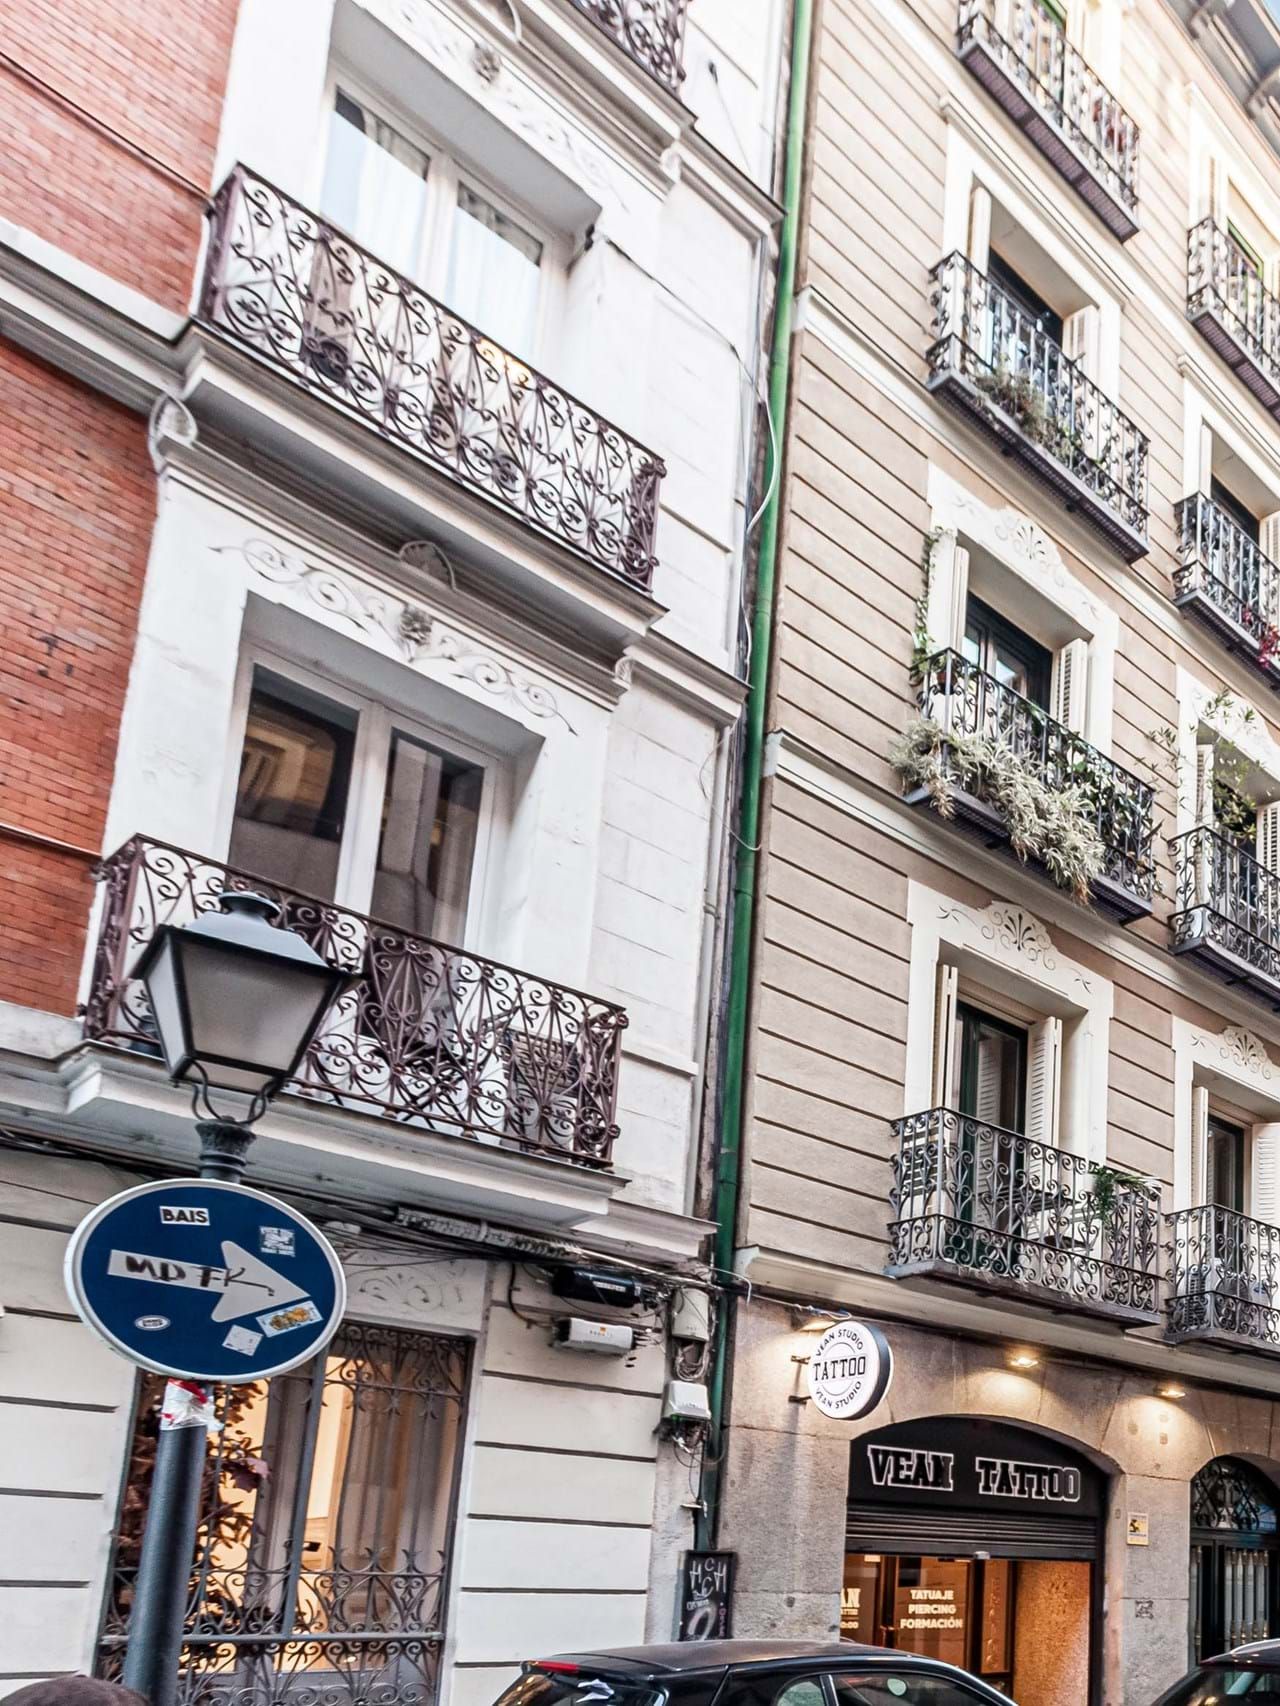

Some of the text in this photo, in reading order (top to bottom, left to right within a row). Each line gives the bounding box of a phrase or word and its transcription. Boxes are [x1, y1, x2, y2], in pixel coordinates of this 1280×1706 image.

[162, 1208, 209, 1224] BAIS
[816, 1328, 864, 1356] VEAN STUDIO
[814, 1356, 866, 1381] TATTOO
[835, 1381, 862, 1409] STUDIO
[867, 1444, 1080, 1502] VEAN TATTOO
[910, 1590, 954, 1600] TATUAJE
[908, 1604, 957, 1614] PIERCING
[900, 1616, 963, 1629] FORMACIÓN
